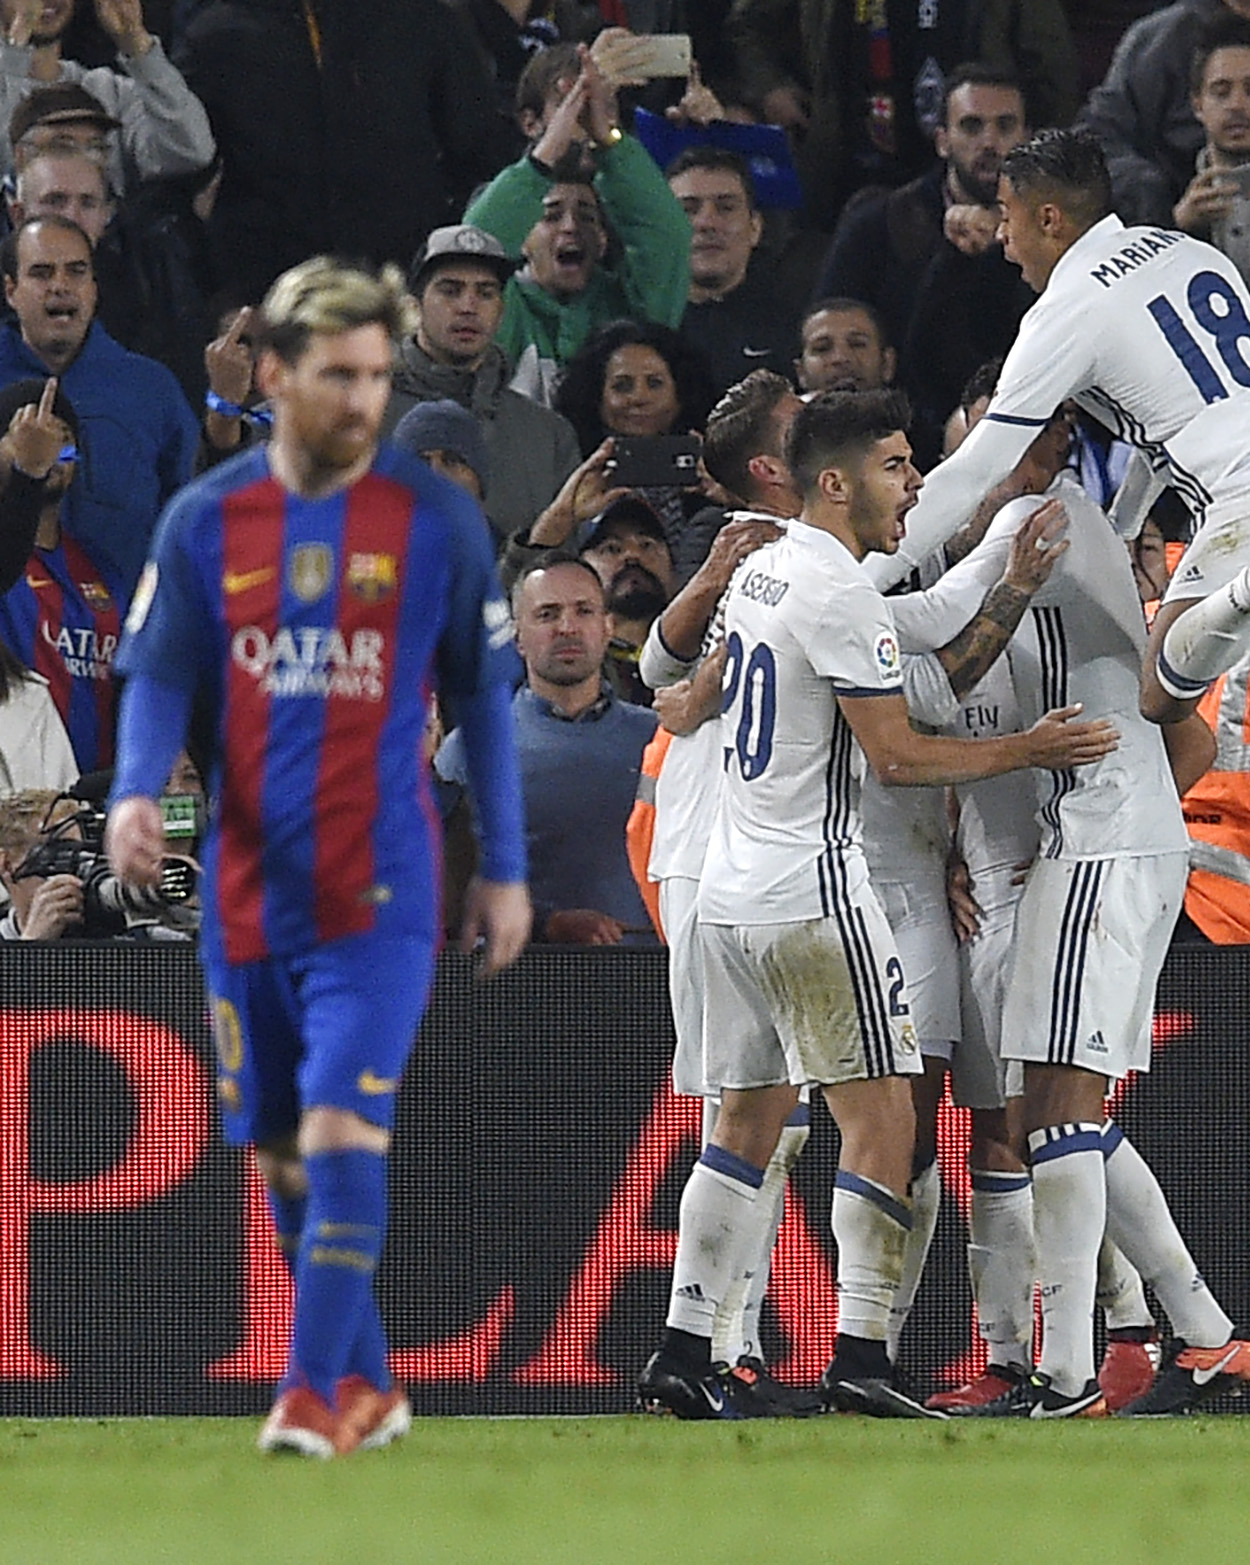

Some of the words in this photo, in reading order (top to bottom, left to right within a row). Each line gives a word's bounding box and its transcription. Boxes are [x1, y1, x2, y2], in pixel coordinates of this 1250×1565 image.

[230, 625, 386, 680] QATAR
[964, 704, 999, 731] Fly
[886, 956, 910, 1017] 2
